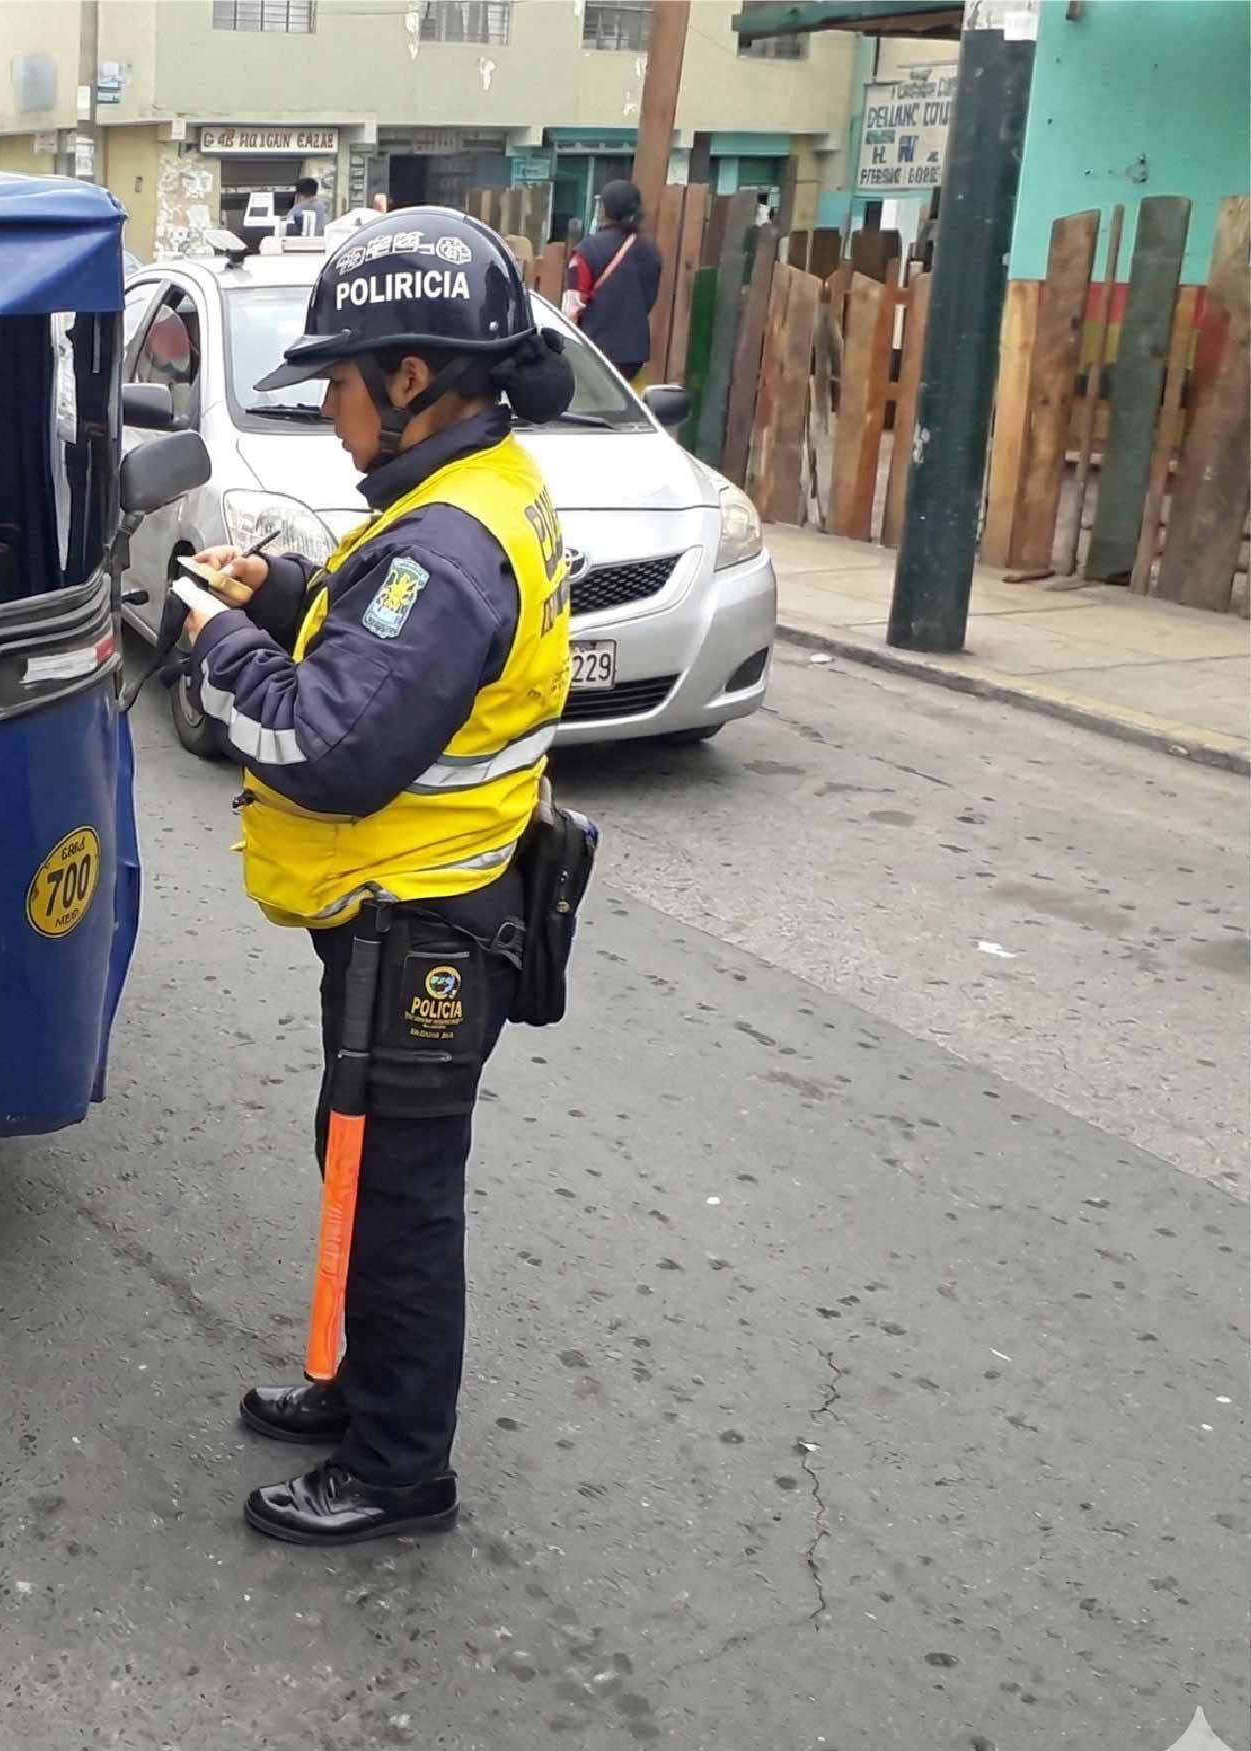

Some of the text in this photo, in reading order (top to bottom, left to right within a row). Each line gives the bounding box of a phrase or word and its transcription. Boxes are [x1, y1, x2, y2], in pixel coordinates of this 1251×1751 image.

[336, 269, 471, 311] POLIRICIA
[571, 653, 612, 683] 229
[46, 853, 91, 917] 700
[410, 996, 463, 1019] POLICIA
